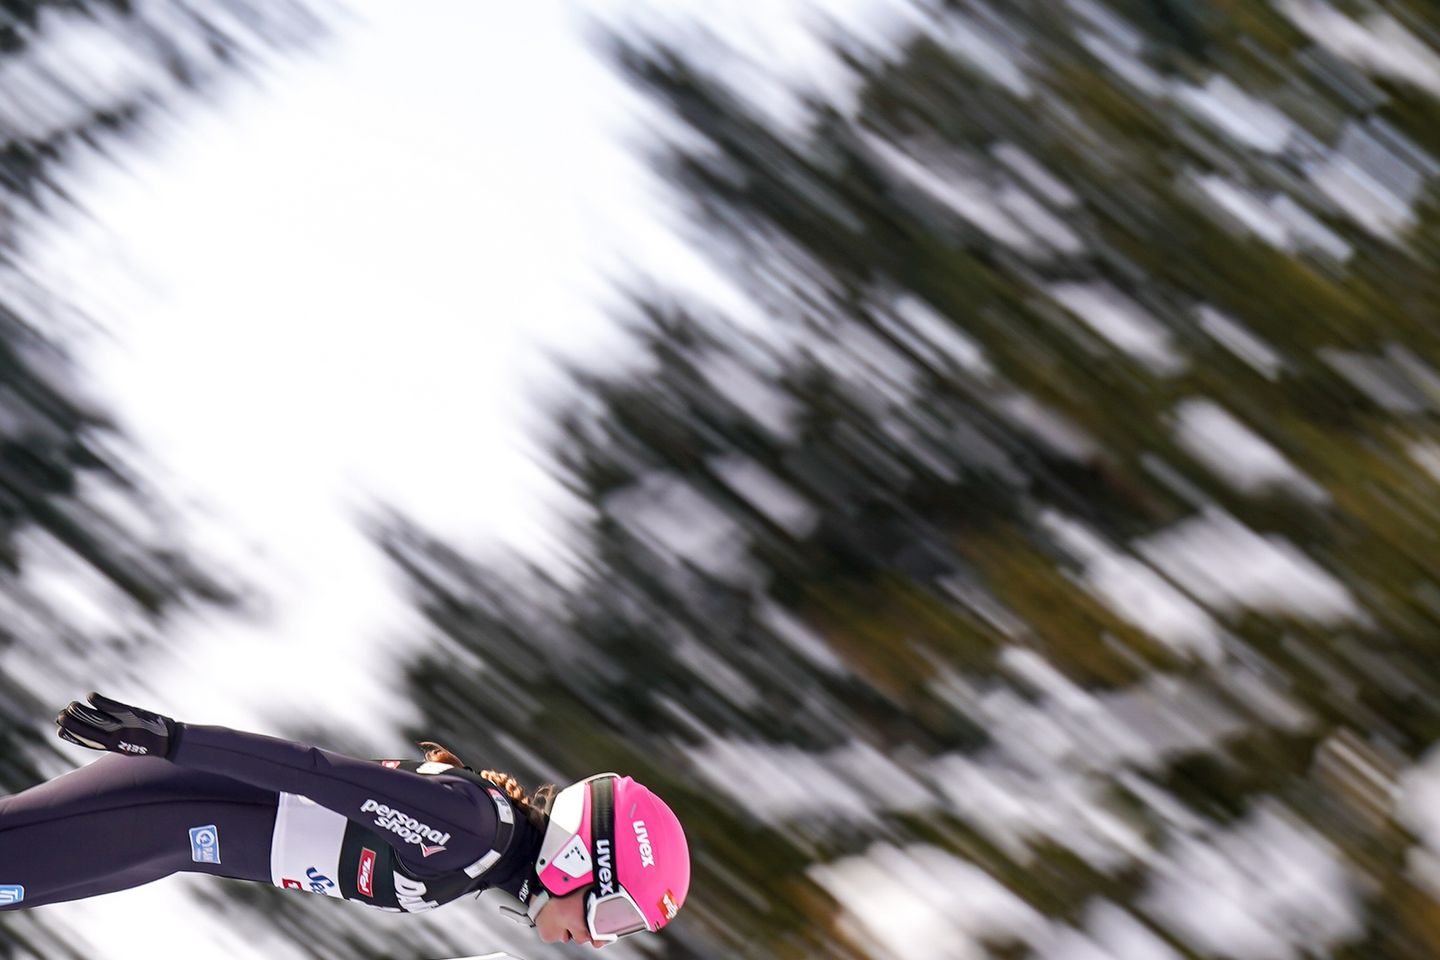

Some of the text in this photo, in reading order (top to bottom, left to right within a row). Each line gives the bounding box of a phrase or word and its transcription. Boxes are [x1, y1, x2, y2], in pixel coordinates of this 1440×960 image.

[360, 799, 451, 846] personal
[374, 816, 423, 845] shop
[632, 820, 656, 868] uvex
[596, 839, 614, 896] uvex
